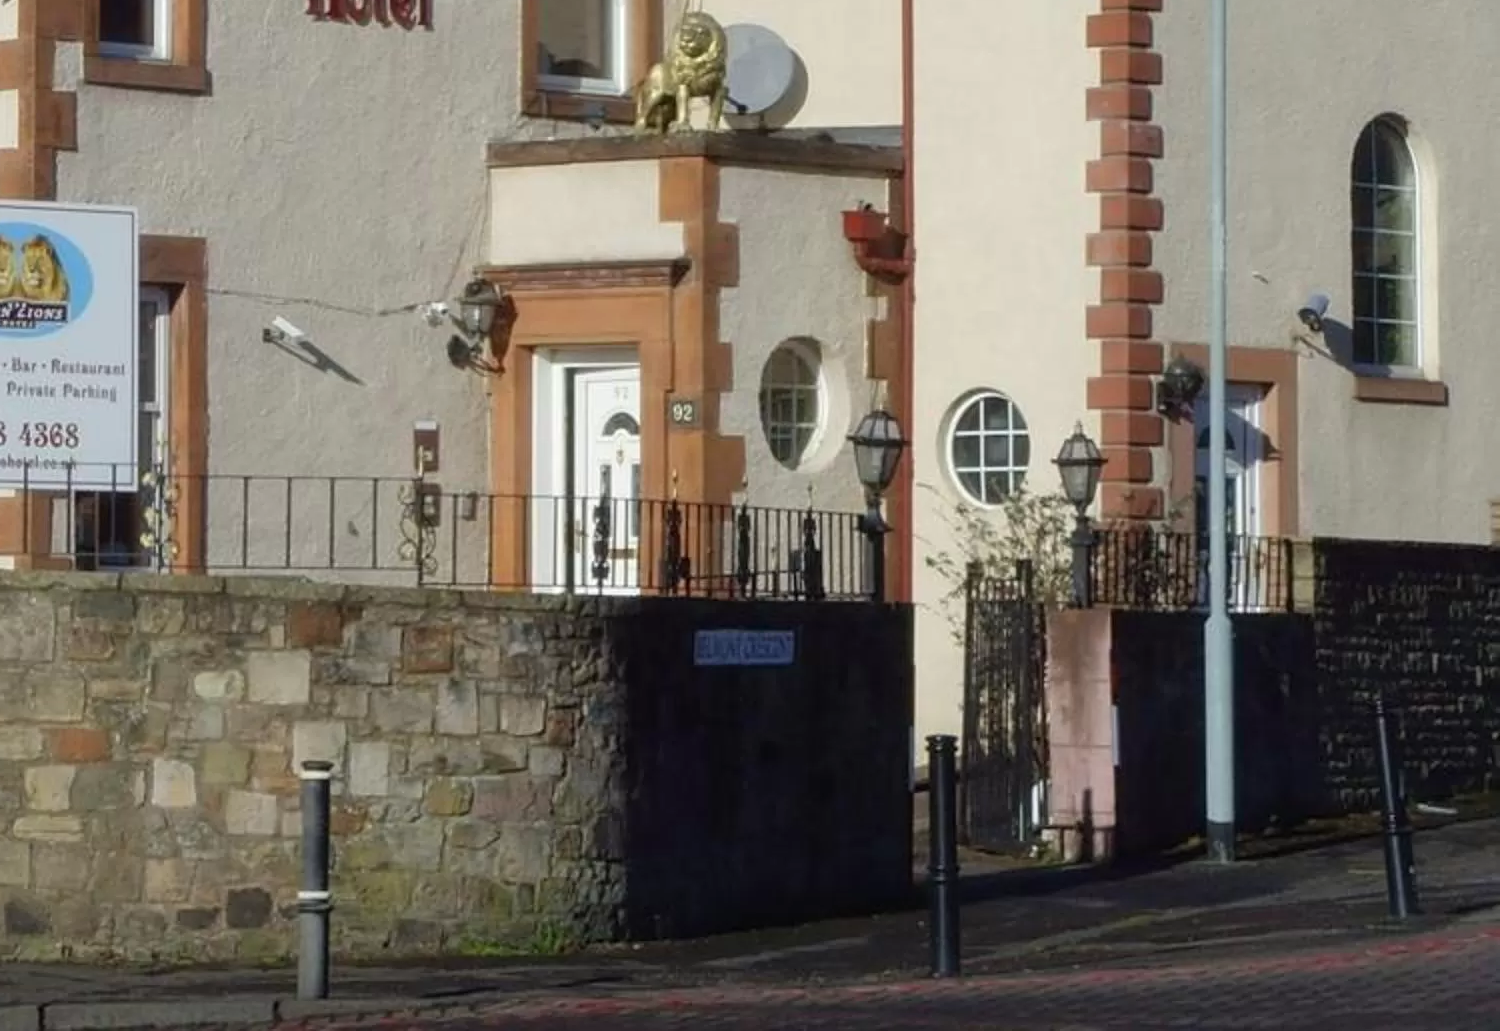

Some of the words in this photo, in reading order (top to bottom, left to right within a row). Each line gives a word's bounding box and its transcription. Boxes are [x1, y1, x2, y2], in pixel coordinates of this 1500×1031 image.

[11, 357, 37, 373] Bar
[51, 358, 125, 375] Restaurant
[7, 380, 56, 397] Private
[63, 382, 117, 402] Parking
[672, 403, 693, 422] 92
[18, 422, 80, 449] 4368
